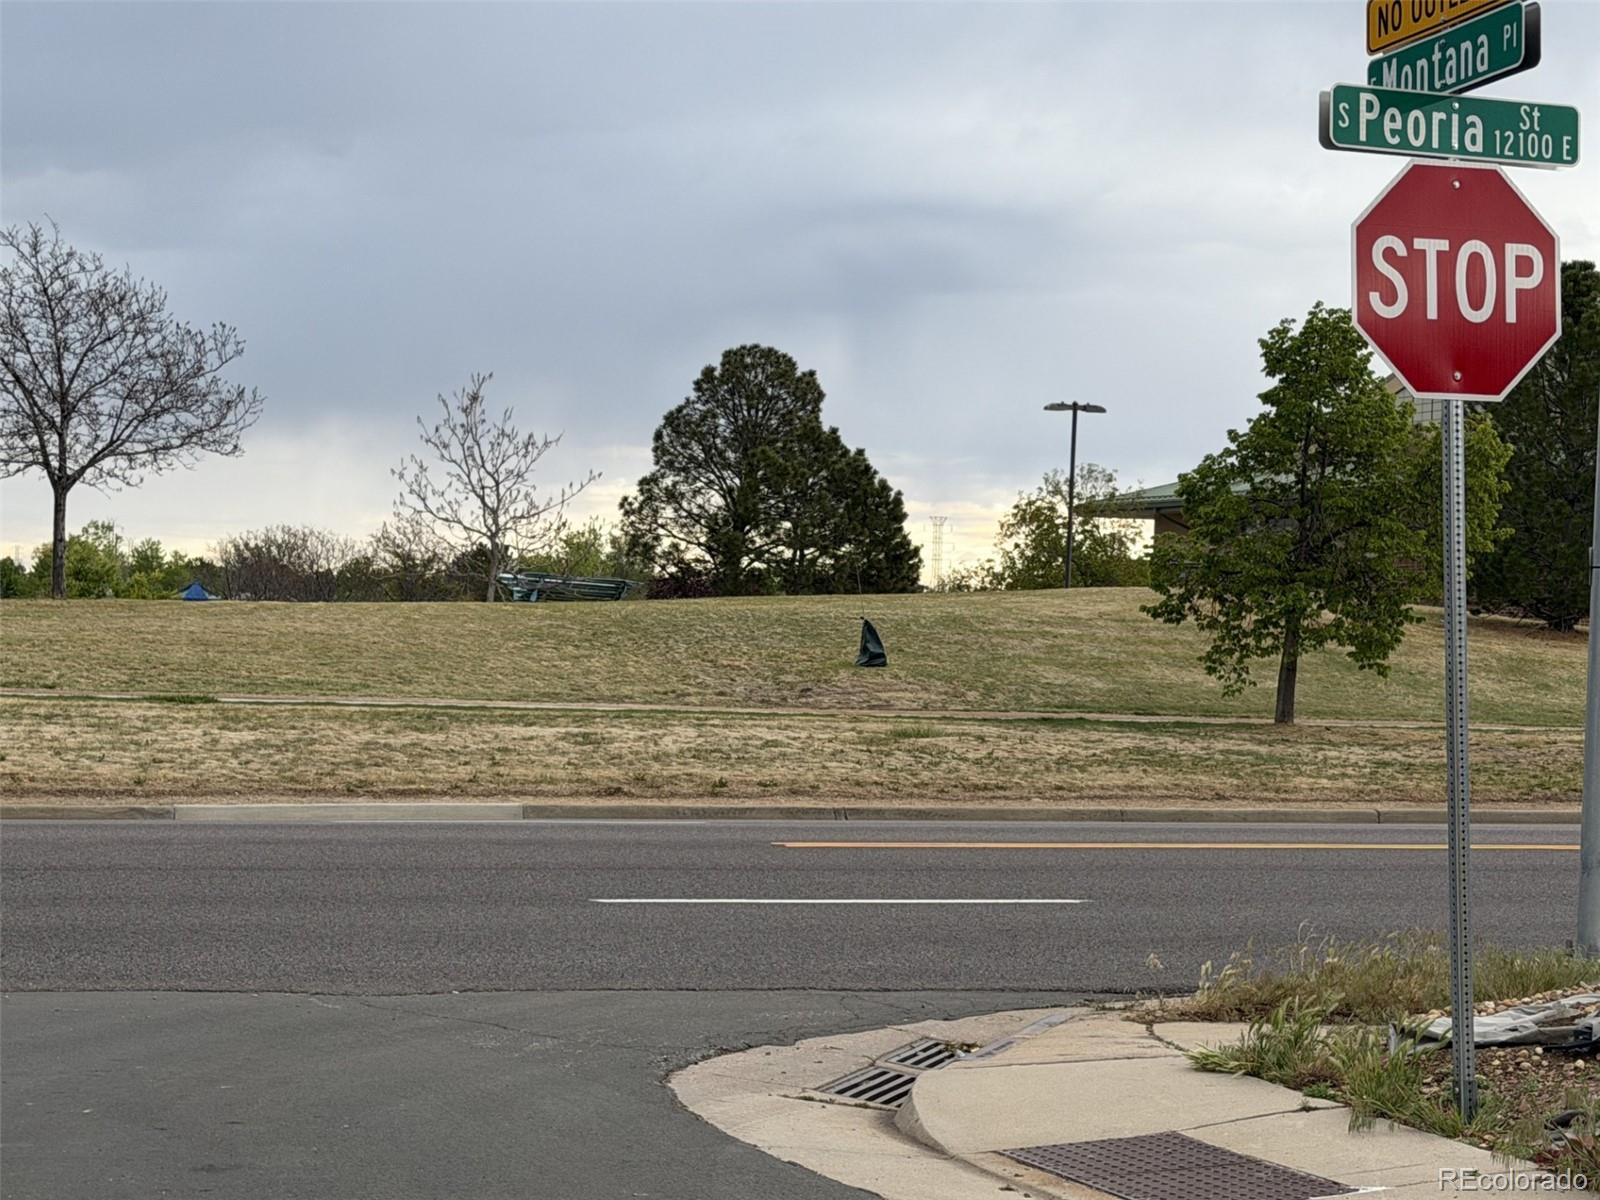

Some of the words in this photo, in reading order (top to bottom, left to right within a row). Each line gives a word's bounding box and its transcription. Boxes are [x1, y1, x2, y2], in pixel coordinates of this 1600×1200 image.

[1378, 1, 1402, 38] NO
[1382, 34, 1489, 93] Montana
[1503, 22, 1517, 51] Pl
[1338, 102, 1350, 128] S
[1359, 92, 1483, 153] Peoria
[1519, 104, 1541, 132] St
[1494, 130, 1553, 159] 12100
[1563, 136, 1572, 160] E
[1369, 235, 1544, 324] STOP
